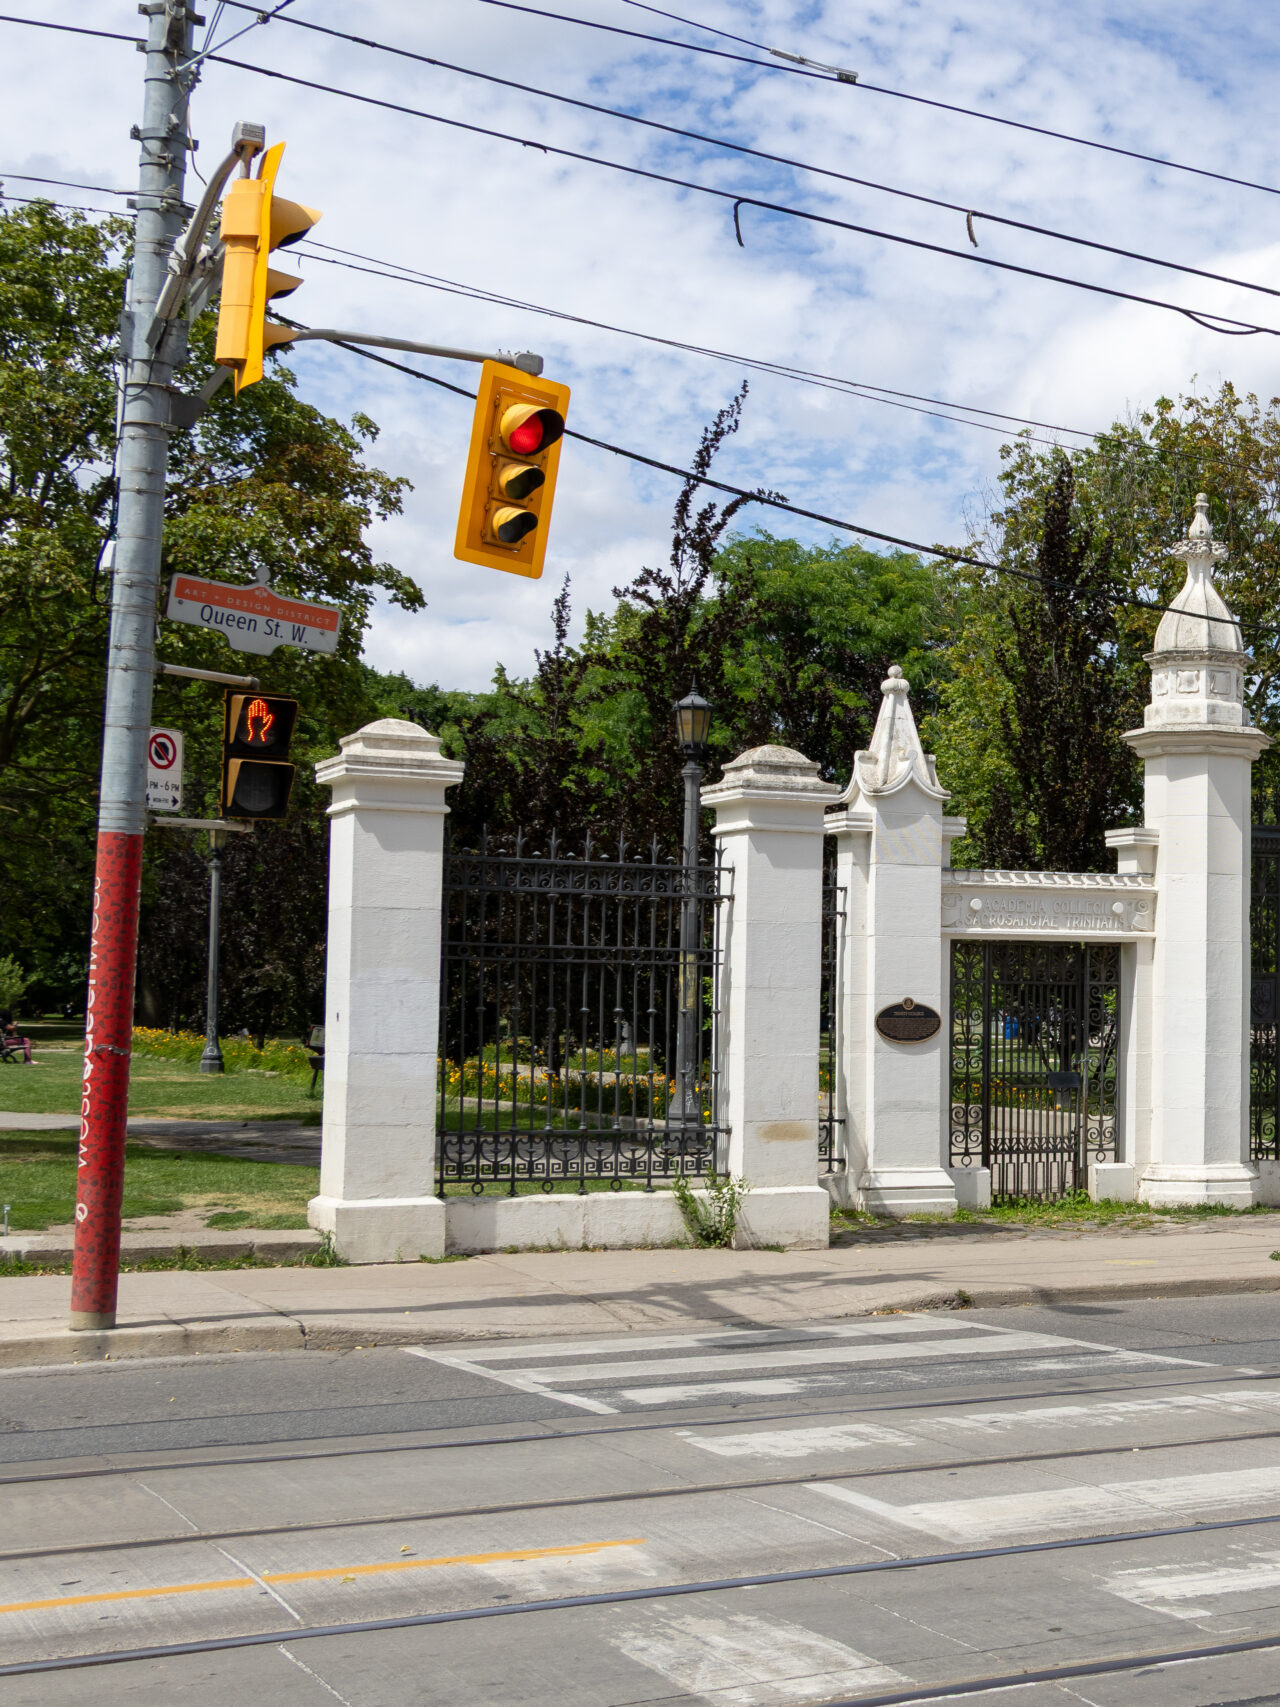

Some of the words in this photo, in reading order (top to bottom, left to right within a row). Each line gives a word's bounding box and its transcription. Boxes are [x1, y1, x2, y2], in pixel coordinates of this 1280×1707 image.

[183, 587, 207, 599] ART
[226, 596, 271, 613] DESIGN
[277, 608, 332, 626] DISTRICT
[200, 604, 258, 633] Queen
[263, 618, 284, 639] St.
[291, 624, 309, 644] W.
[983, 898, 1046, 914] ACADEMIA
[965, 913, 1058, 928] SACROSANCTAE
